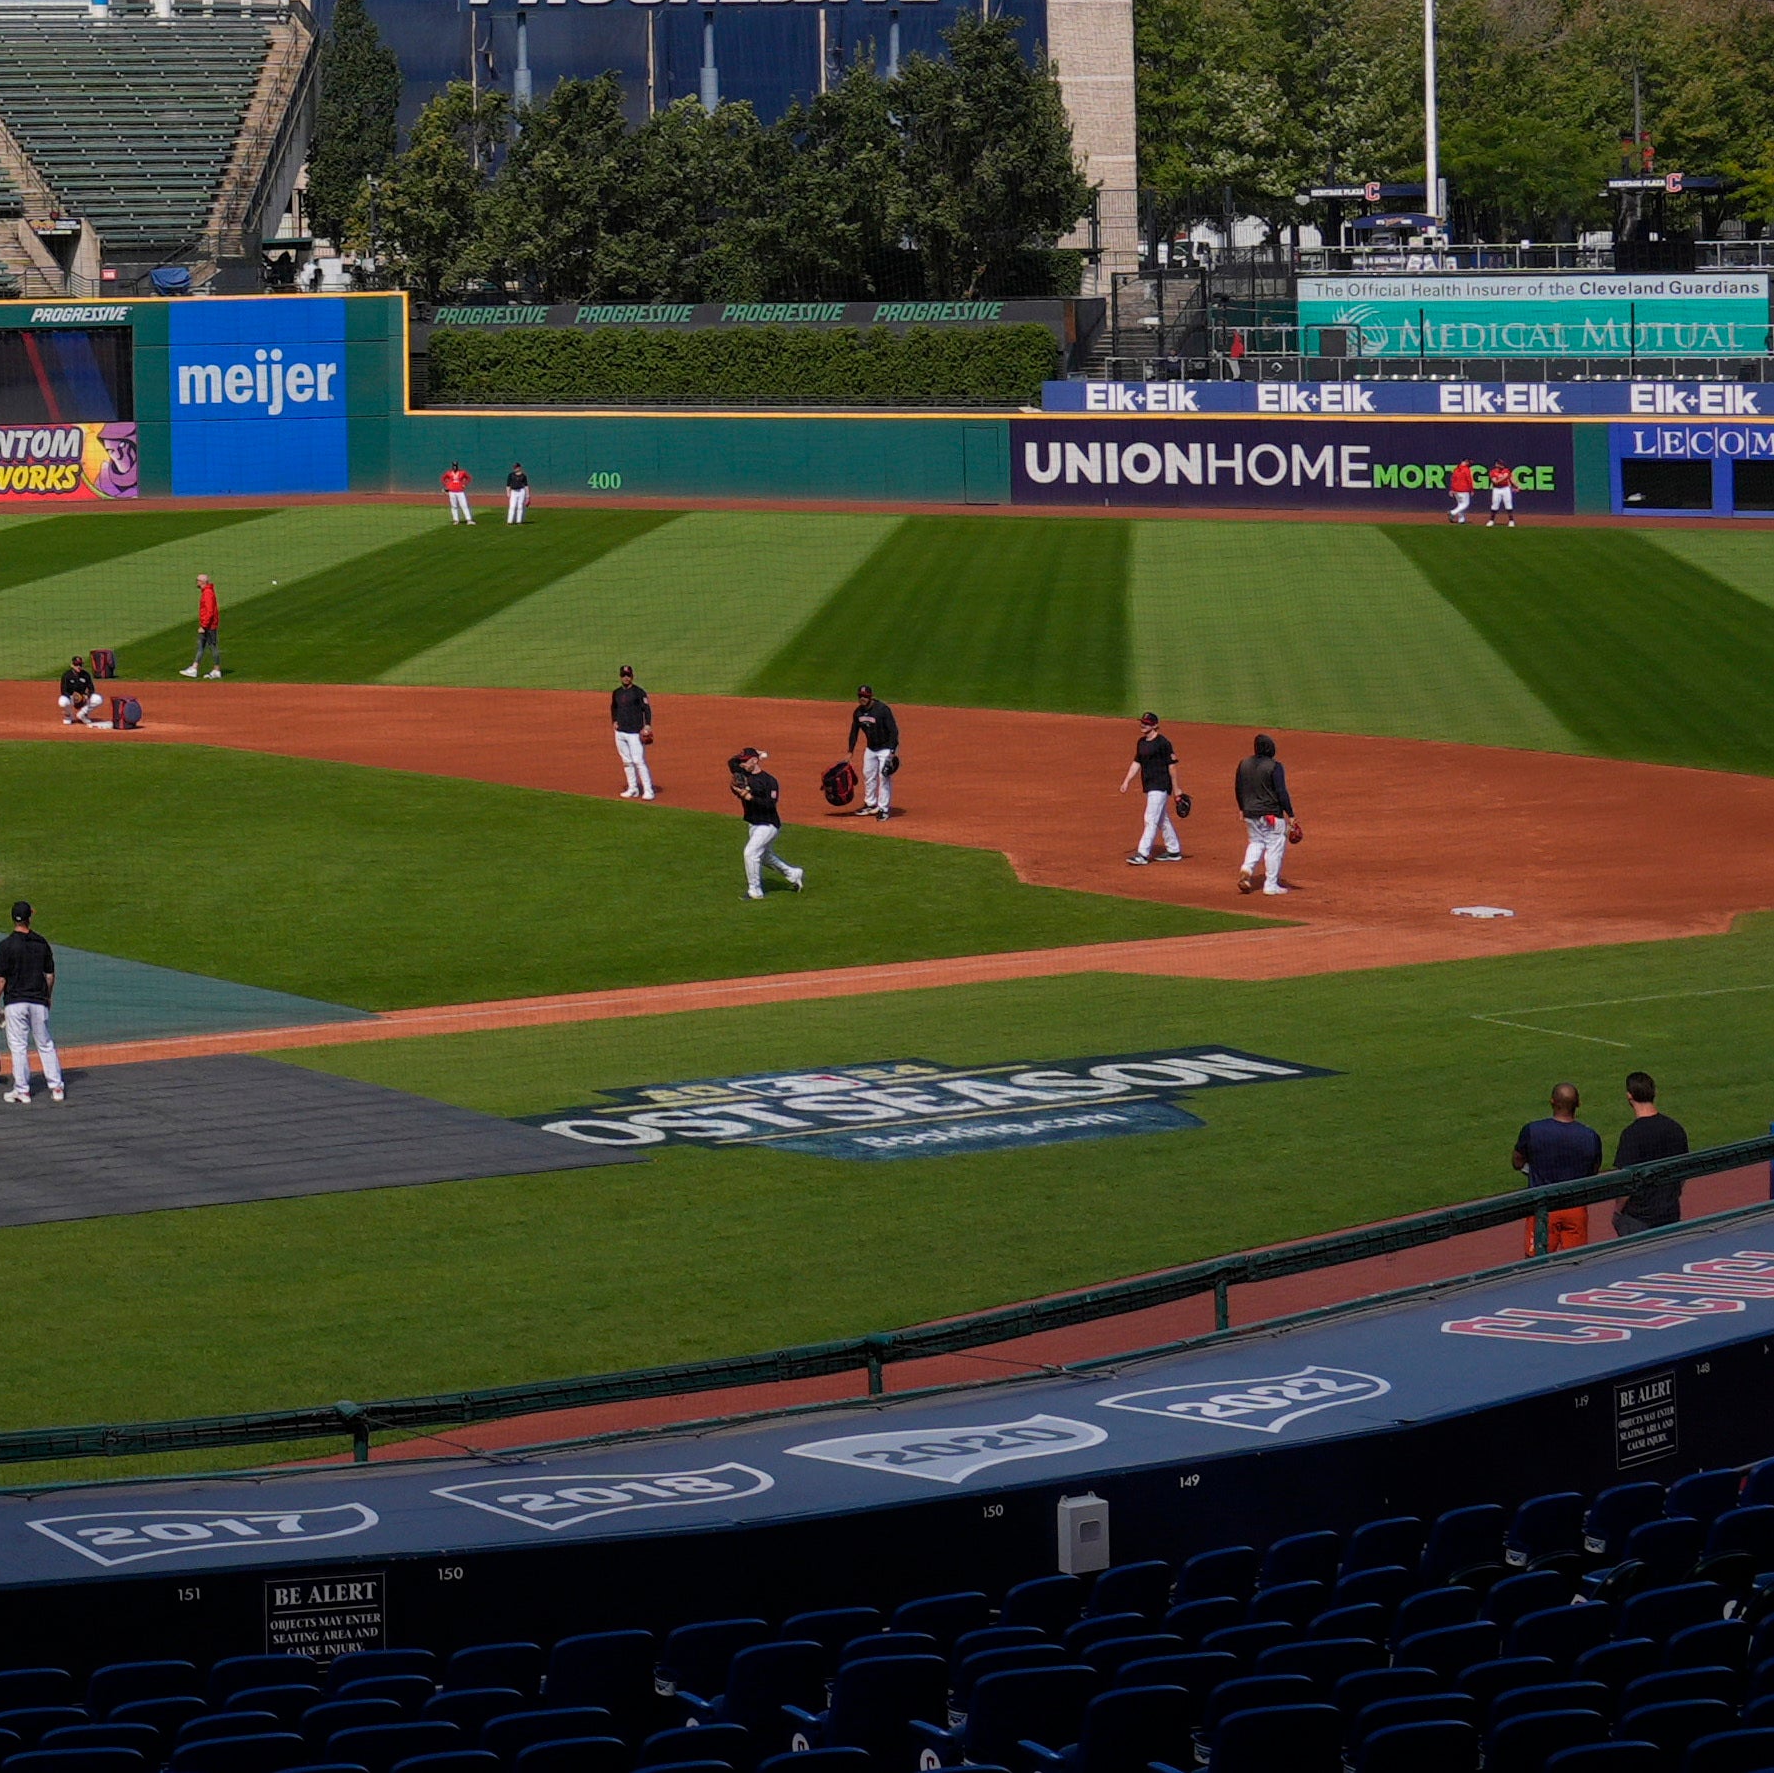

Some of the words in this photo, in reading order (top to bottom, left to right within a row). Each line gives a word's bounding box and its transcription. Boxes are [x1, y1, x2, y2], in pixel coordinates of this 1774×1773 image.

[1314, 283, 1344, 297] The
[1348, 282, 1406, 297] Official
[1411, 281, 1461, 297] Health
[1466, 281, 1522, 297] Insurer
[1527, 281, 1544, 296] of
[1549, 281, 1575, 296] the
[1579, 279, 1664, 296] Cleveland
[1669, 279, 1760, 294] Guardians
[30, 306, 128, 323] PROGRESSIVE
[433, 305, 549, 327] PROGRESSIVE
[574, 304, 694, 324] PROGRESSIVE
[720, 303, 845, 323] PROGRESSIVE
[871, 301, 1004, 322] PROGRESSIVE
[1399, 317, 1571, 350] MEDICAL
[1581, 316, 1745, 349] MUTUAL
[179, 348, 335, 417] meijer
[1085, 382, 1200, 412] Elk+Elk
[1257, 382, 1376, 413] Elk+Elk
[1439, 382, 1563, 414] Elk+Elk
[1630, 383, 1759, 415] Elk+Elk
[587, 471, 623, 490] 400
[1373, 464, 1555, 492] MORTGGE
[541, 1053, 1303, 1147] OSTSEASON
[854, 1109, 1130, 1152] Booking.com
[1166, 1375, 1358, 1423] 2022
[1619, 1389, 1635, 1408] BE
[1637, 1379, 1672, 1403] ALERT
[865, 1421, 1064, 1467] 2020
[494, 1467, 734, 1515] 2018
[1179, 1474, 1201, 1488] 149
[983, 1504, 1005, 1518] 150
[75, 1511, 310, 1548] 2017
[176, 1587, 202, 1602] 151
[274, 1586, 303, 1606] BE
[306, 1580, 377, 1604] ALERT
[437, 1566, 465, 1582] 150
[269, 1617, 317, 1632] OBJECTS
[319, 1614, 343, 1628] MAY
[344, 1611, 382, 1625] ENTER
[272, 1630, 321, 1644] SEATING
[323, 1628, 353, 1642] AREA
[354, 1626, 381, 1639] AND
